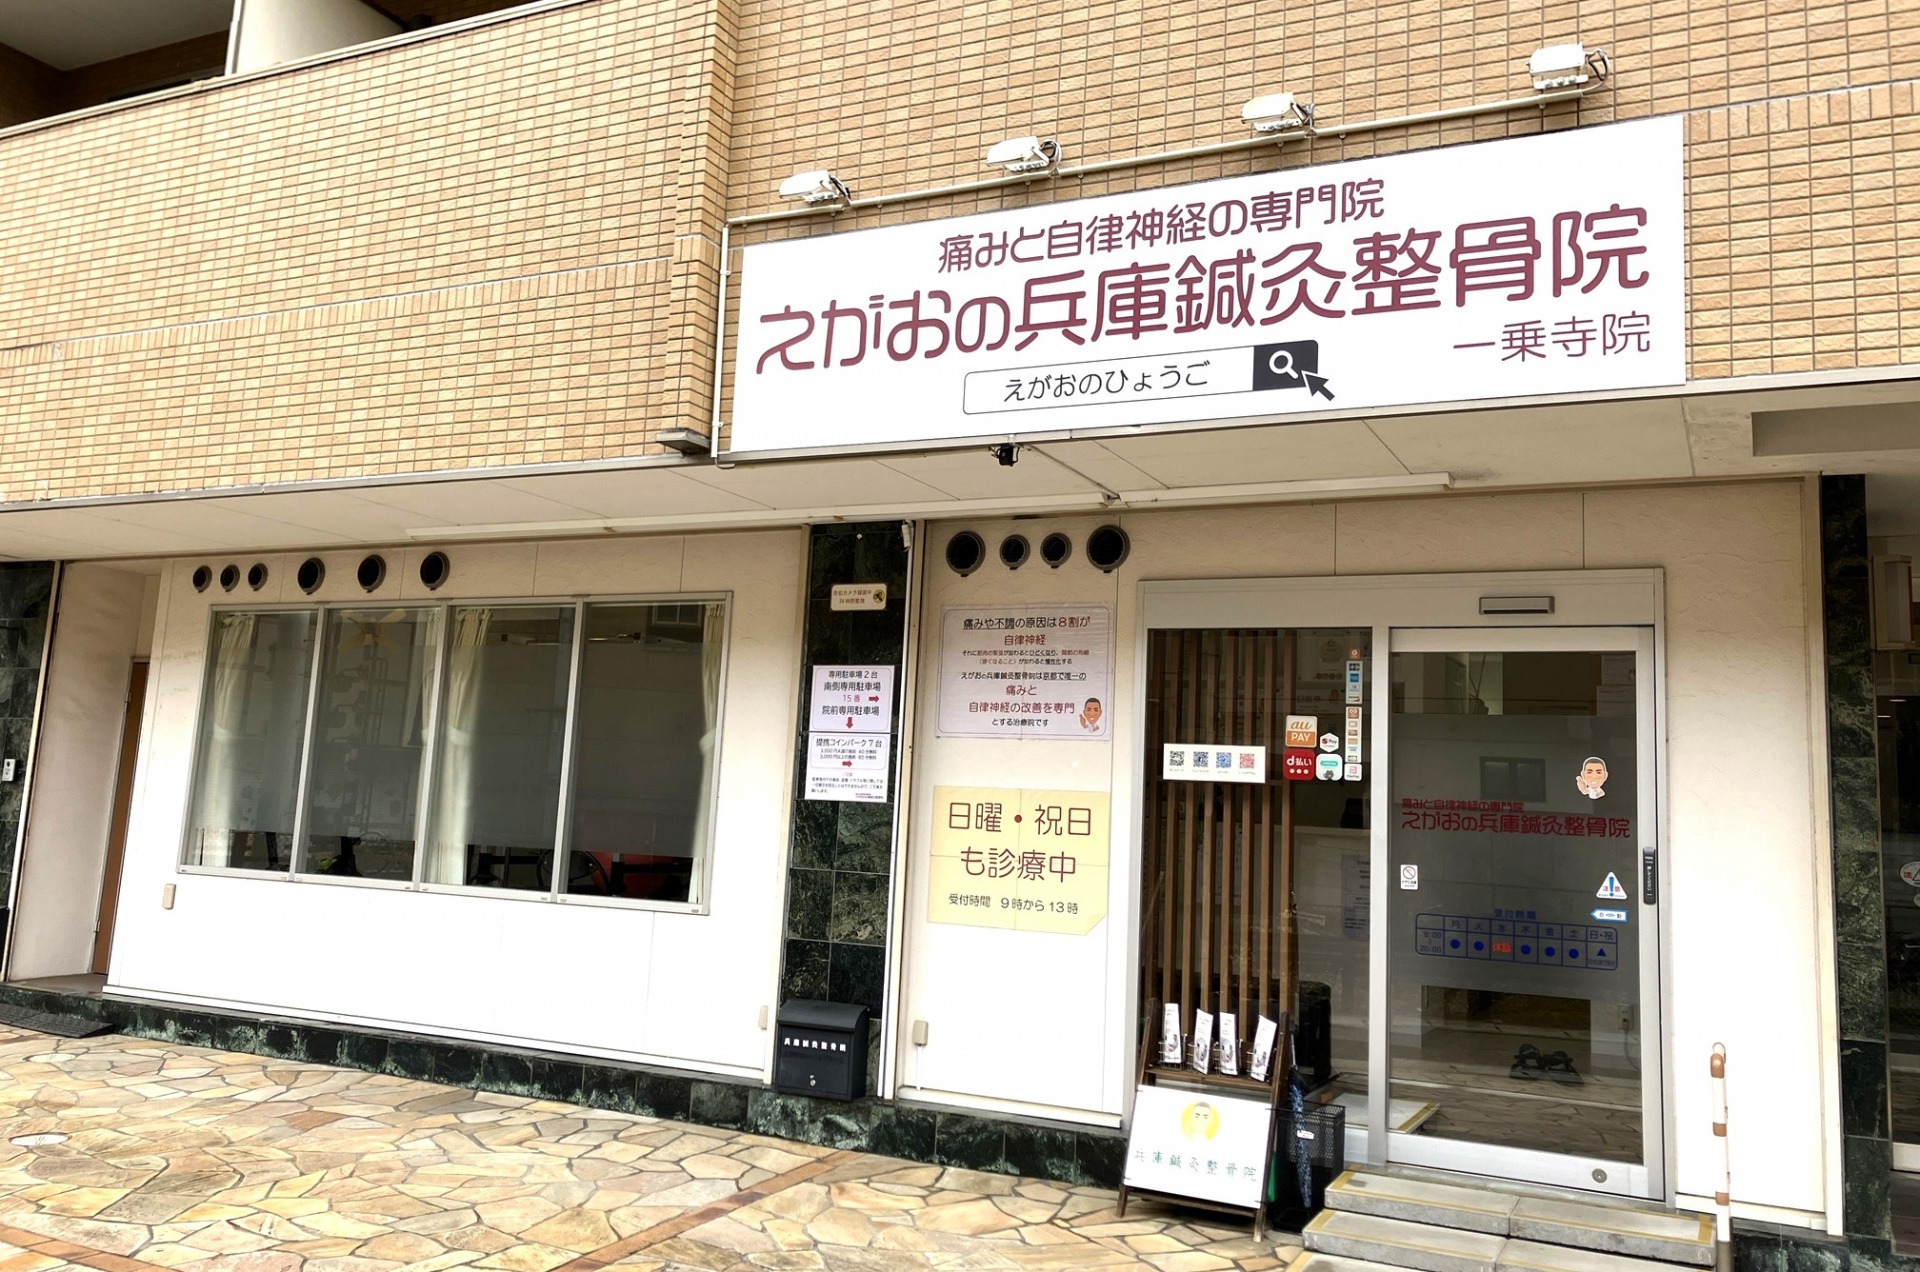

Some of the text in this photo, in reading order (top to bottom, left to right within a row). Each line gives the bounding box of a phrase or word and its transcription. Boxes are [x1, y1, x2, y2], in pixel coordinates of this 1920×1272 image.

[939, 177, 1385, 272] 痛みと自律神経の専門院
[756, 203, 1650, 374] えがおの兵庫鍼灸整骨院
[1451, 311, 1652, 363] 一乗寺院
[1003, 359, 1211, 403] えがおのひょうご
[1004, 634, 1046, 646] 自律神経
[1006, 685, 1037, 696] 痛みと
[969, 702, 1075, 714] 自律神経の改善を専門
[992, 718, 1049, 727] とする治療院です
[1291, 721, 1312, 730] au
[1291, 732, 1311, 741] PAY
[1286, 755, 1312, 766] d払い
[1401, 798, 1525, 813] 痛みと自律神経の専門院
[949, 802, 1091, 836] 日曜・祝日
[1401, 811, 1630, 838] えがおの兵庫鍼灸整骨院
[960, 846, 1076, 883] も診療中
[948, 893, 991, 908] 受付時間
